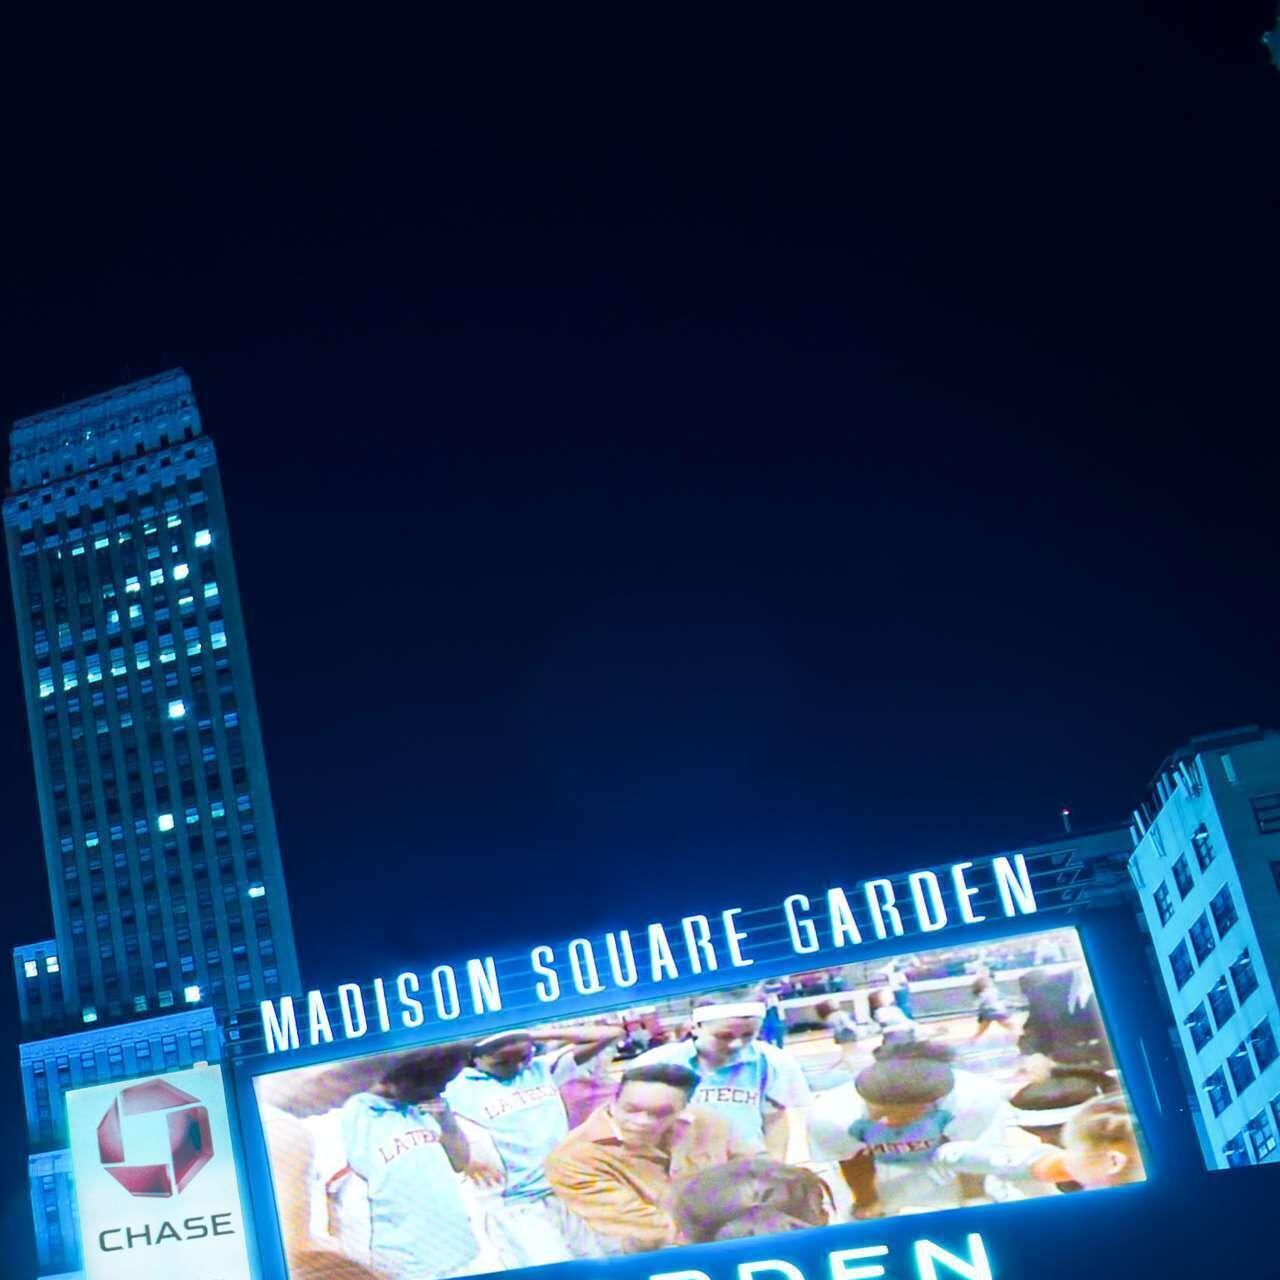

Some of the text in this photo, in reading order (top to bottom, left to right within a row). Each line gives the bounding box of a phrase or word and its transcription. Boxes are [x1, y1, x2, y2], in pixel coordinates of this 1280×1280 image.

[259, 853, 1038, 1053] MADISON SQUARE GARDEN
[699, 1087, 758, 1105] TECH
[98, 1212, 236, 1252] CHASE
